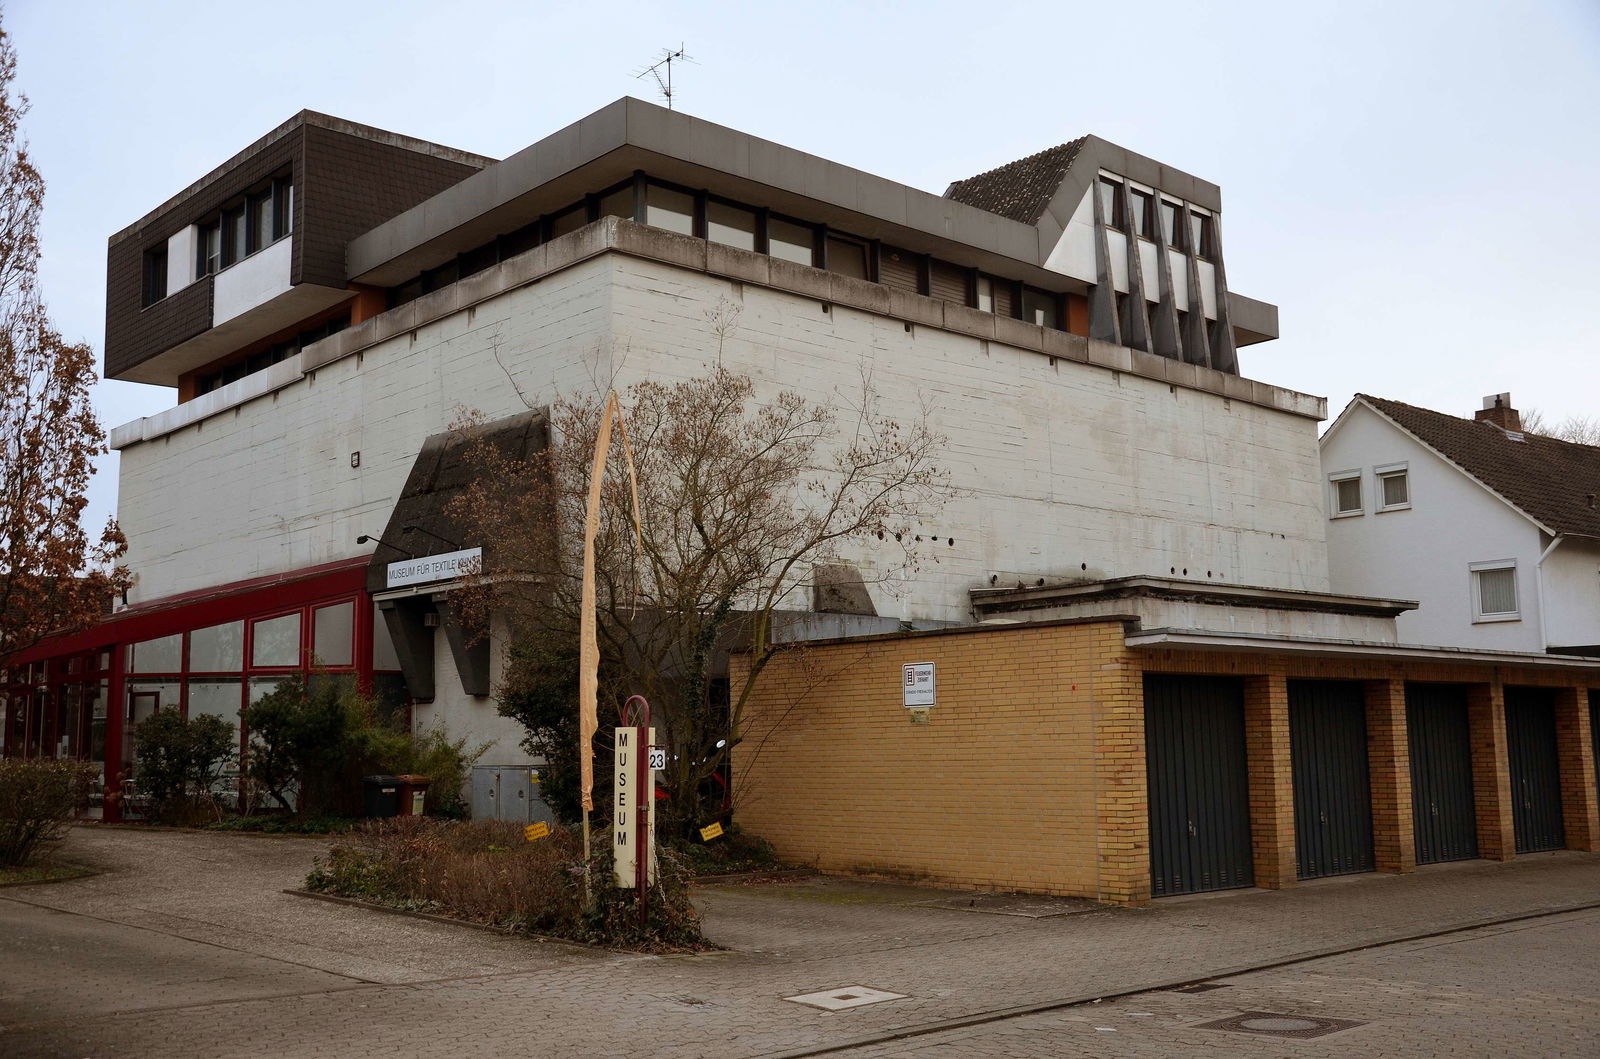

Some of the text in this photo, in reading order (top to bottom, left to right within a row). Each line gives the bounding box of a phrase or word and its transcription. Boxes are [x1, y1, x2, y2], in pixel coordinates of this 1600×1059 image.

[389, 567, 415, 579] MUSEUM
[417, 563, 430, 575] FÜR
[432, 560, 456, 572] TEXTILE
[649, 754, 664, 769] 23
[617, 733, 628, 846] MUSEUM
